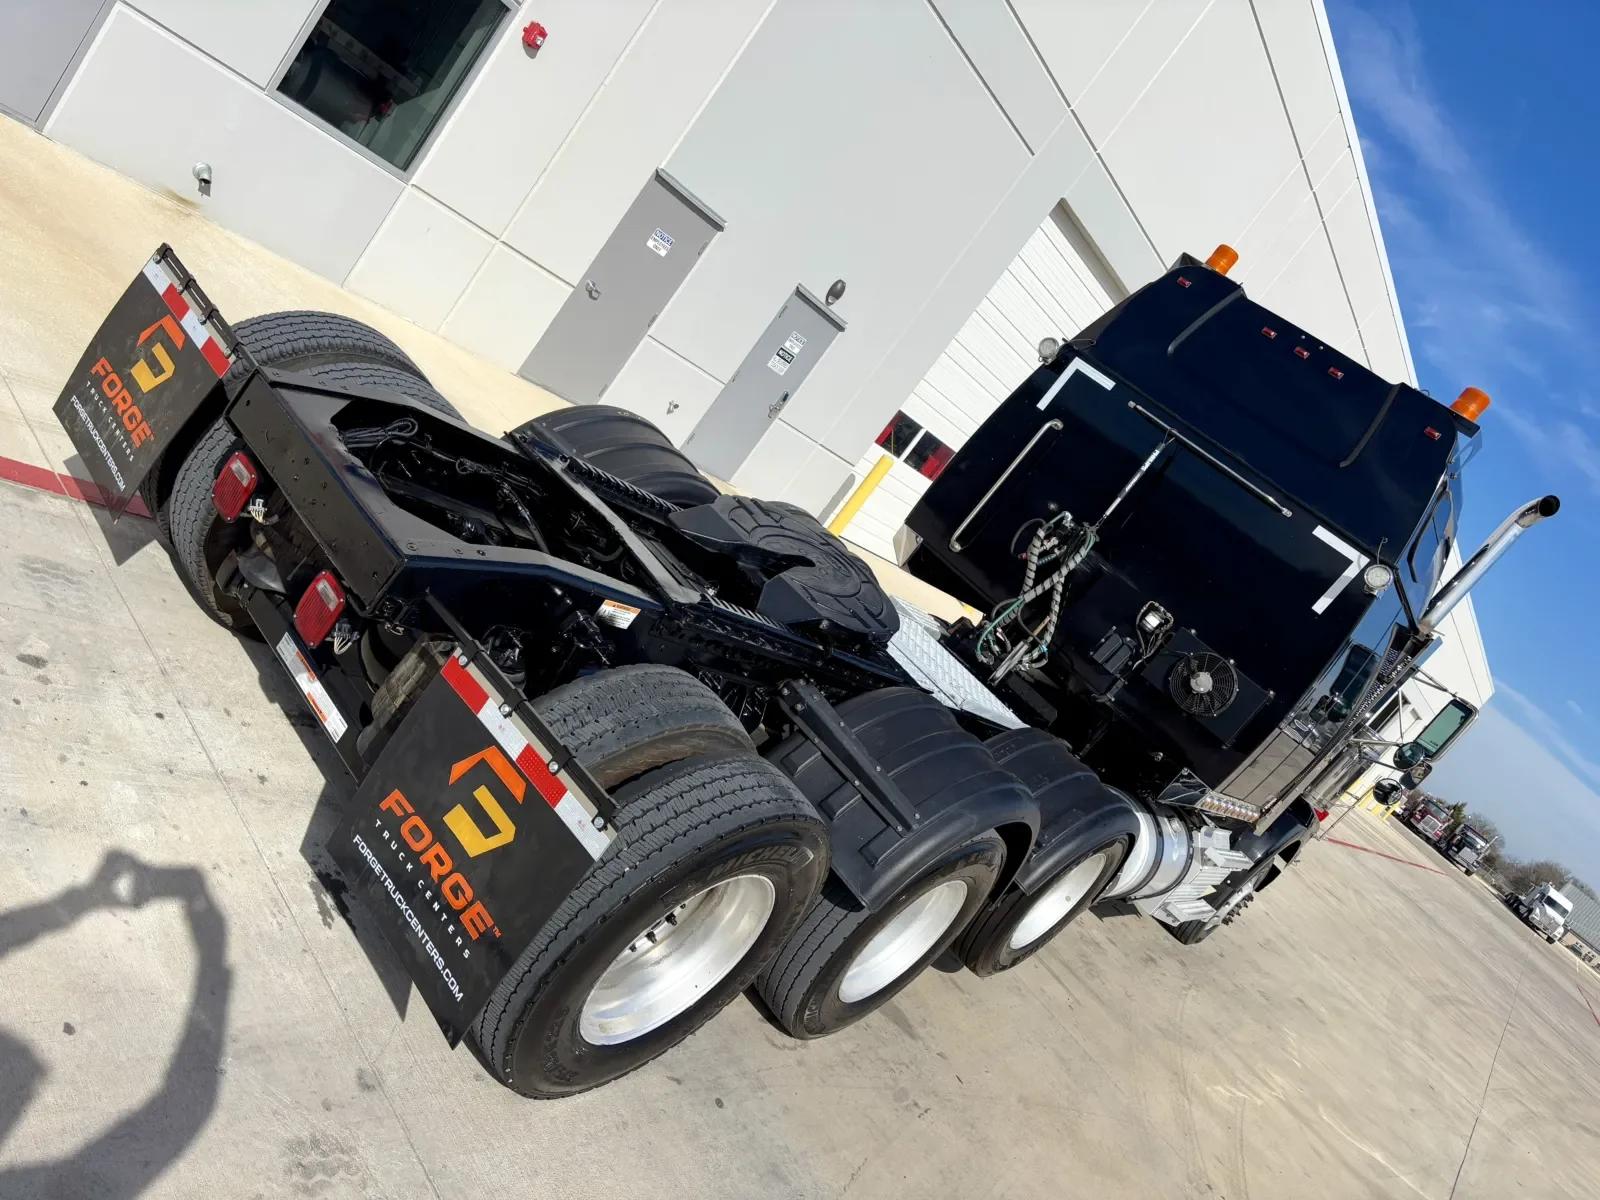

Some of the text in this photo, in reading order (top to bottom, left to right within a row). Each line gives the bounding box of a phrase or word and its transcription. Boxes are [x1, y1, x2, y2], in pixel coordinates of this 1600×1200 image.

[655, 230, 673, 247] NOTICE
[86, 381, 107, 413] TRUCK
[91, 356, 151, 448] FORGE
[70, 395, 126, 492] FORGETRUCKCENTERS.COM
[108, 416, 134, 462] CENTERS
[375, 819, 414, 873] TRUCK
[379, 788, 495, 941] FORGE
[353, 834, 464, 1003] FORGETRUCKCENTERS.COM
[417, 879, 470, 959] CENTERS
